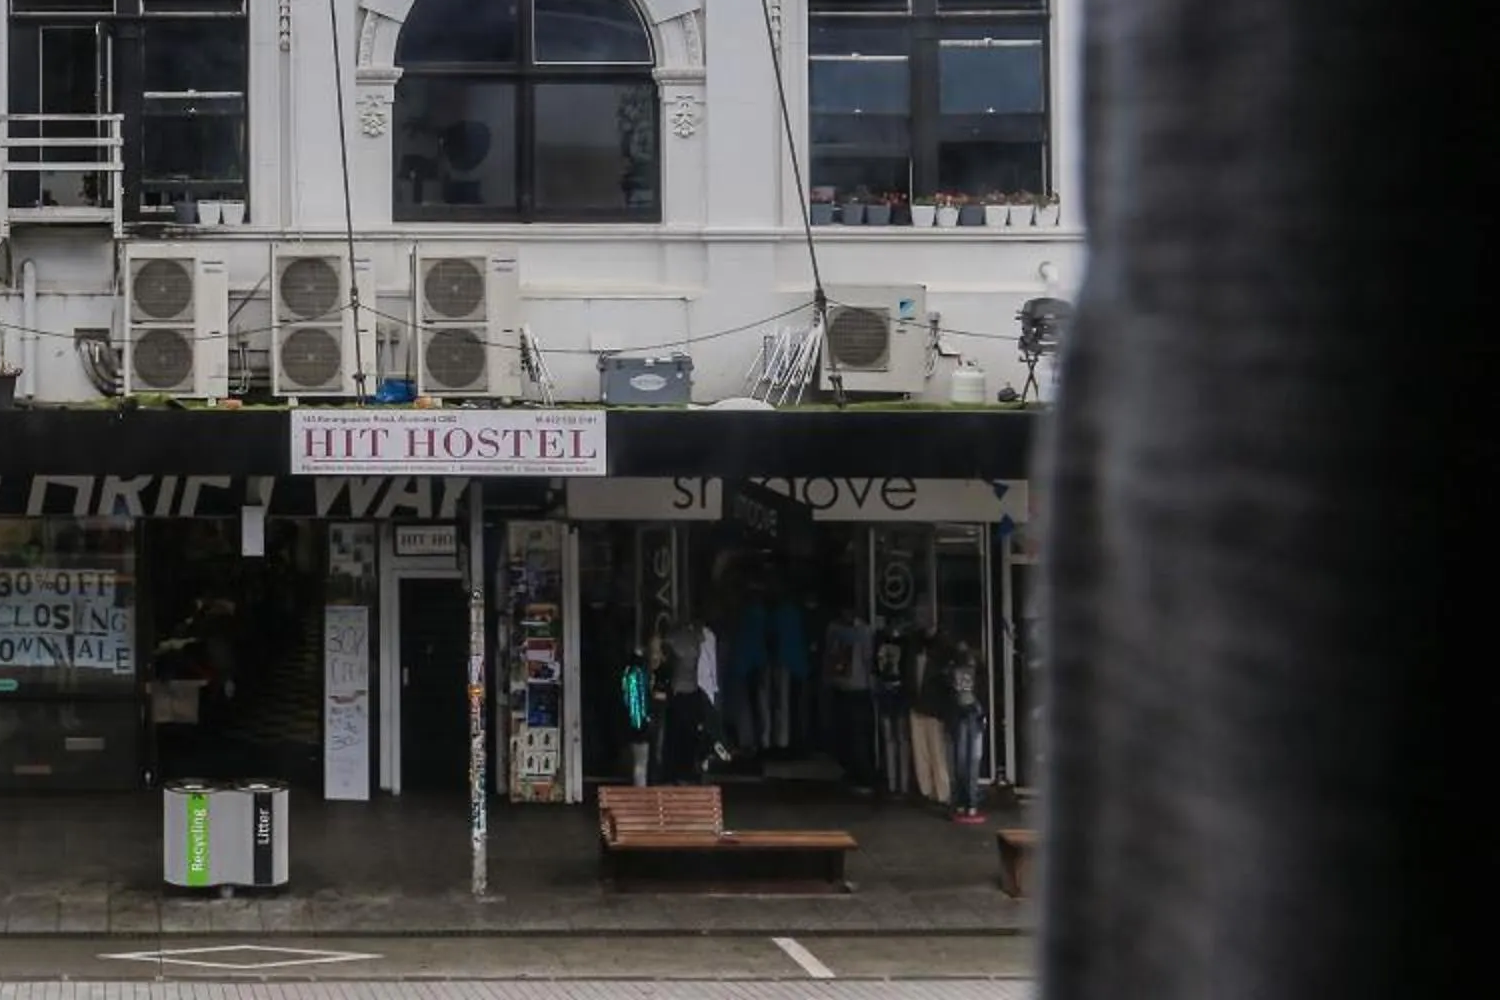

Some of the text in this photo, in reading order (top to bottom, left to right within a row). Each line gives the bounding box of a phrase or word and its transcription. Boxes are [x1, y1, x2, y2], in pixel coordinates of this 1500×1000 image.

[303, 427, 597, 459] HIT HOSTEL
[191, 809, 208, 872] Recycling
[257, 807, 270, 845] Litter
